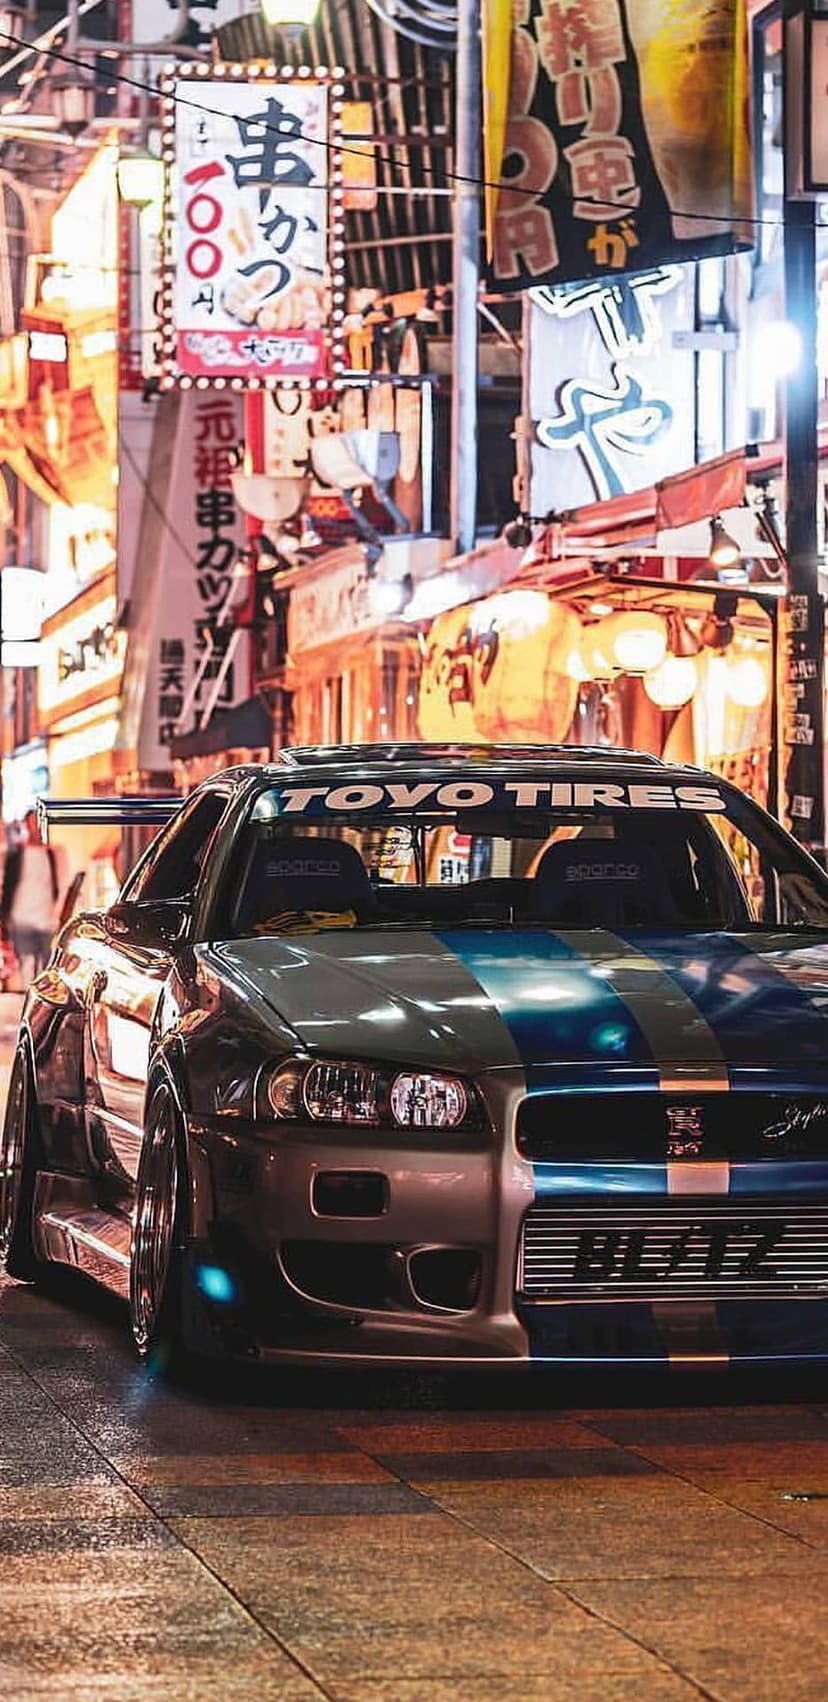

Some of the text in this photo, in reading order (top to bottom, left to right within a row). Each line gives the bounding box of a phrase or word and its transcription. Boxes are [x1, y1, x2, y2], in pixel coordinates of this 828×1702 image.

[225, 96, 319, 303] 串かつ
[281, 781, 726, 812] TOYO TIRES
[566, 863, 641, 881] sparco
[573, 1224, 786, 1280] BLITZ
